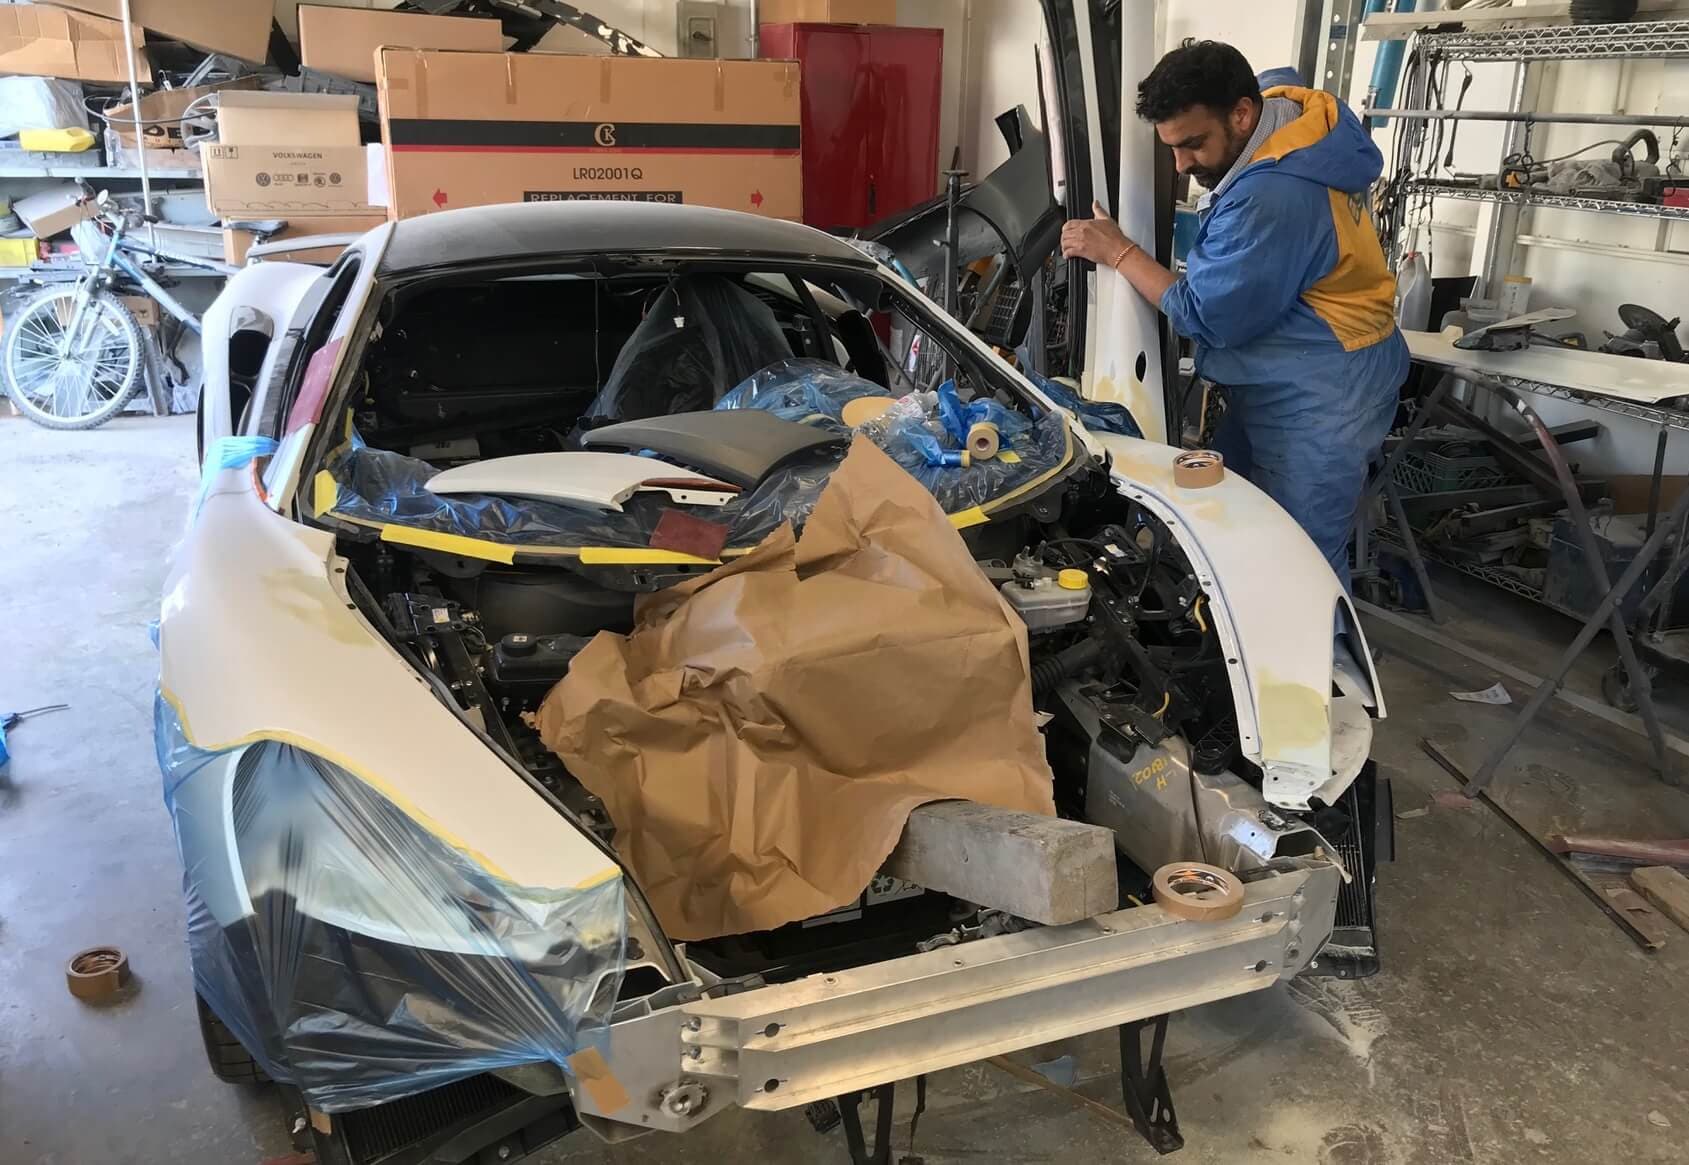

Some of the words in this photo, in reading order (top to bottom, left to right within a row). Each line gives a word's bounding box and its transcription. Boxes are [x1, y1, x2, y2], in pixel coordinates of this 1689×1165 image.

[272, 151, 323, 160] VOLKSWAGEN
[572, 167, 644, 181] LR02001Q
[646, 193, 677, 203] FOR
